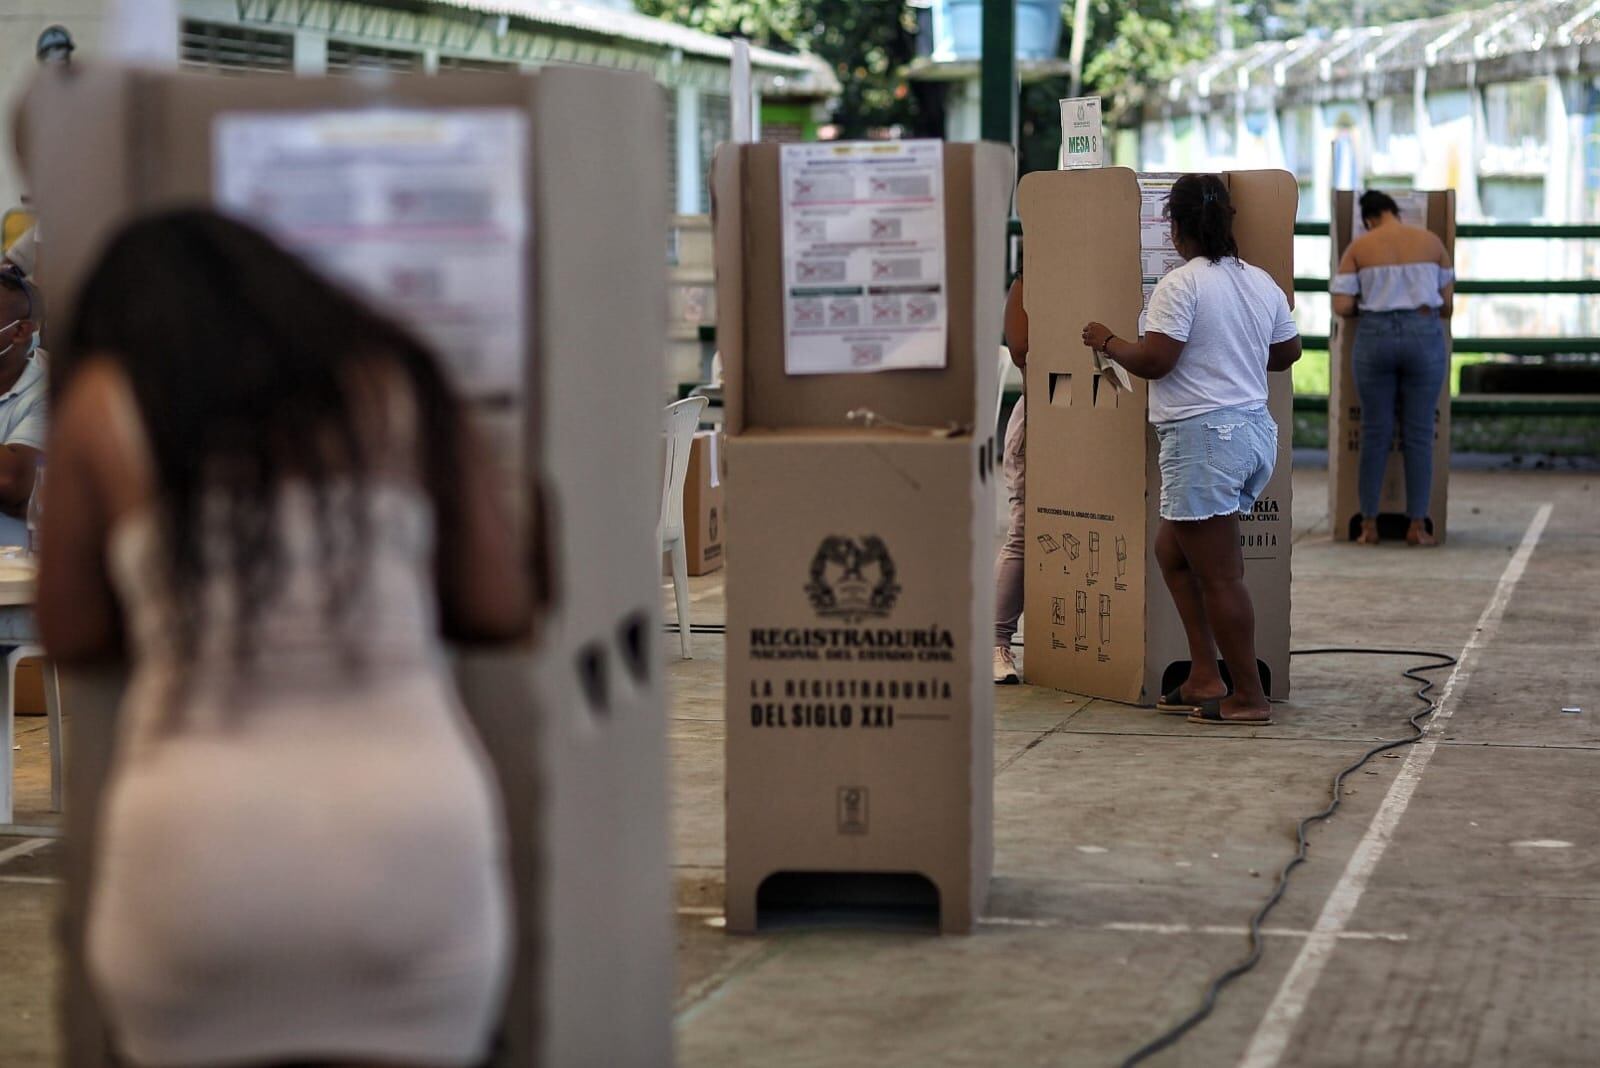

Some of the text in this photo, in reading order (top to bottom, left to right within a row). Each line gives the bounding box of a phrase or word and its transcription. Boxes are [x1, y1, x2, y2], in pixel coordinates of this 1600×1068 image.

[1068, 135, 1090, 153] MESA
[1257, 513, 1280, 521] CIVIL
[750, 624, 954, 648] REGISTRADURÍA
[751, 677, 951, 699] LA REGISTRADURÍA
[751, 704, 893, 727] DEL SIGLO XXI
